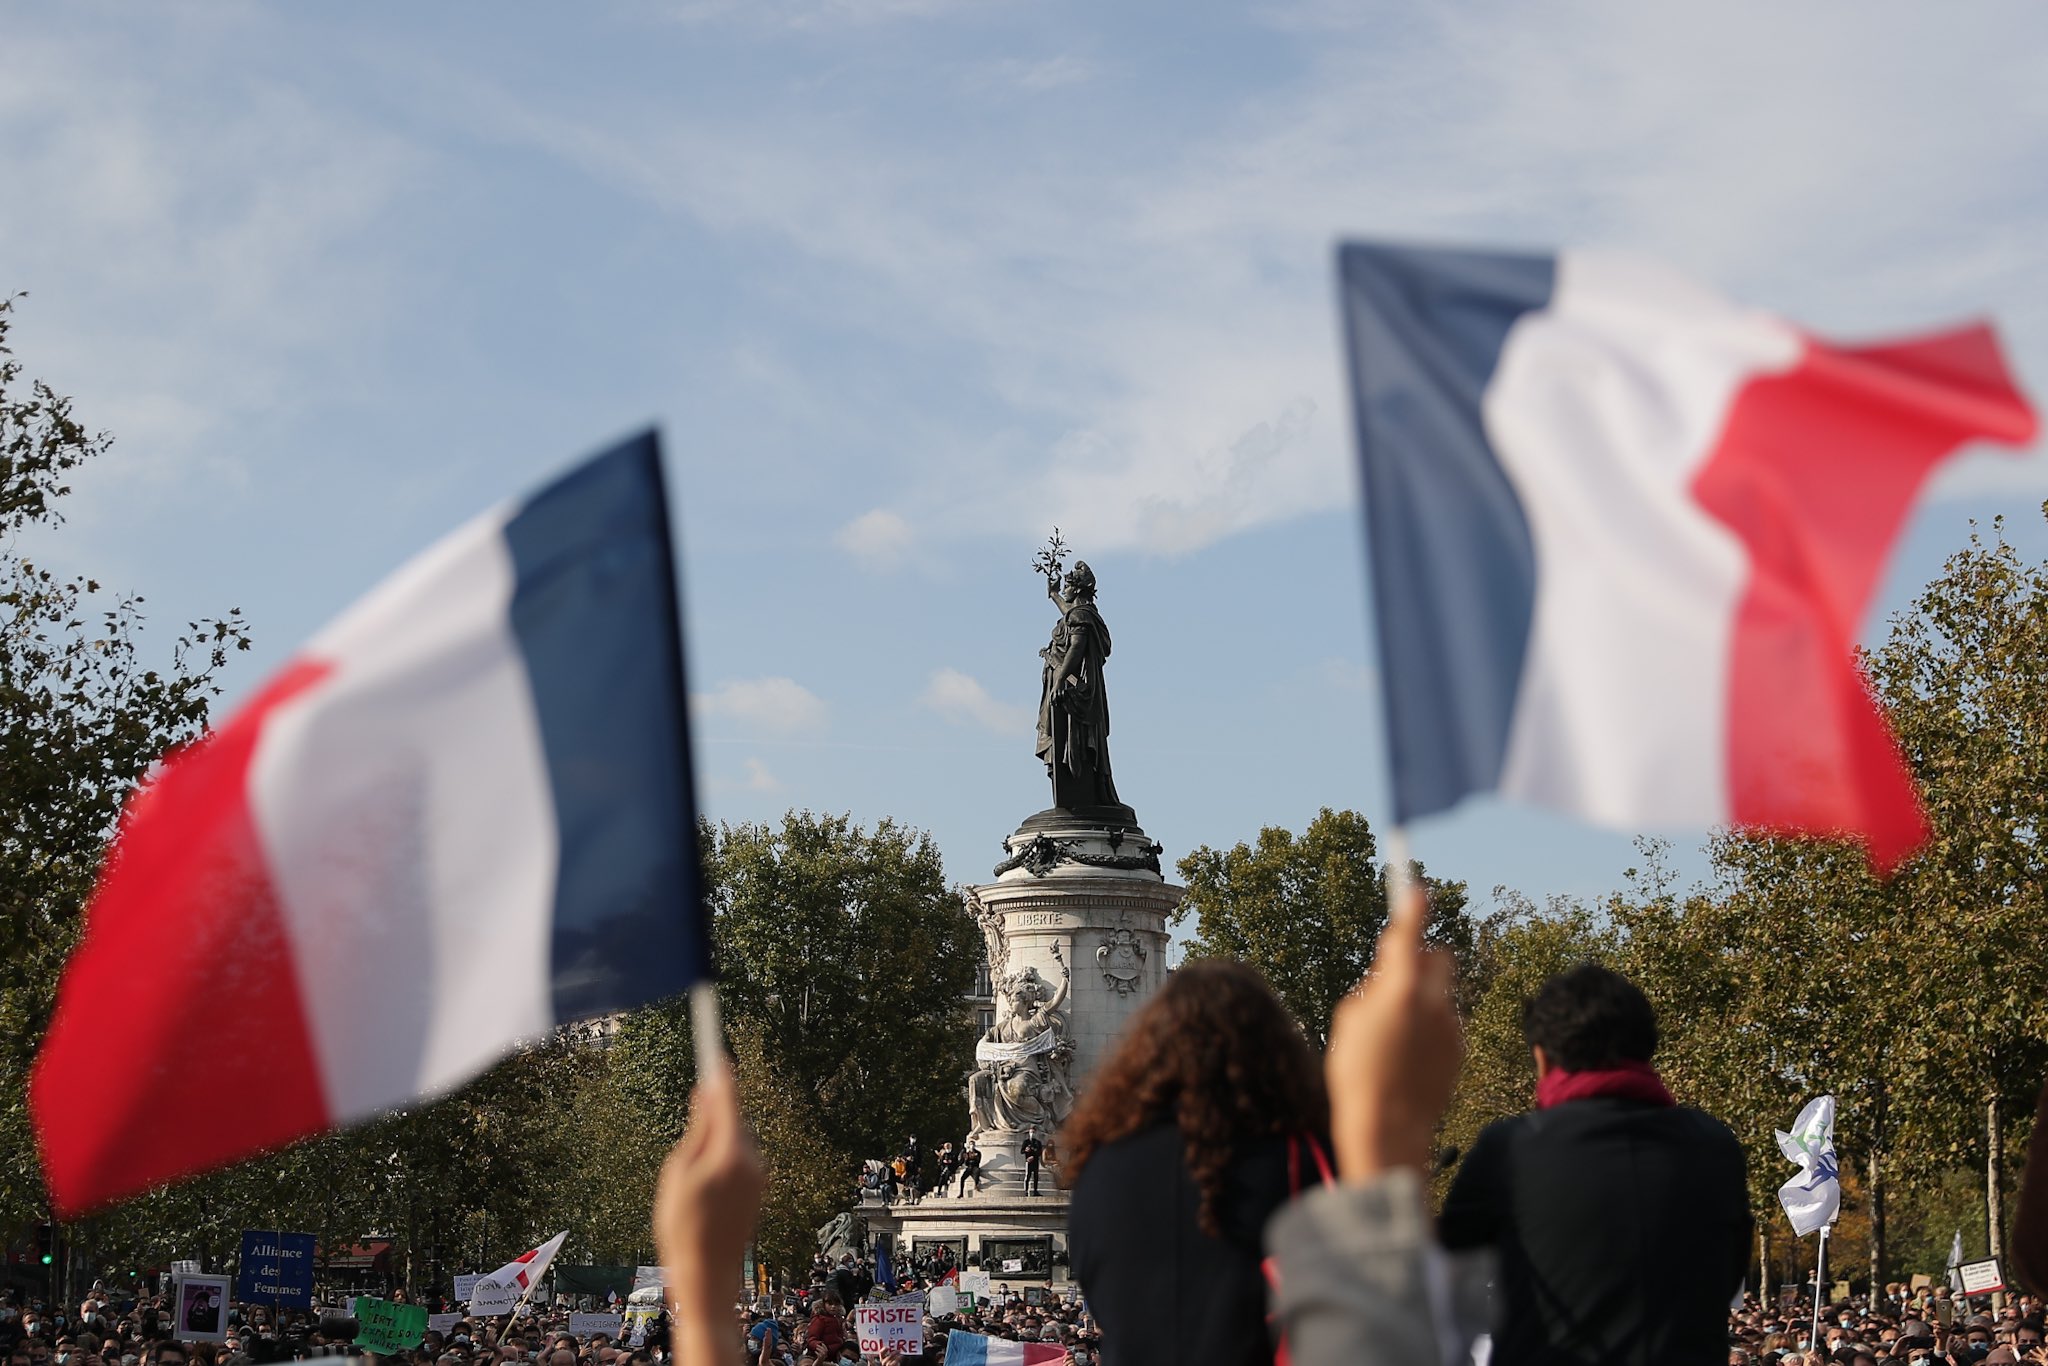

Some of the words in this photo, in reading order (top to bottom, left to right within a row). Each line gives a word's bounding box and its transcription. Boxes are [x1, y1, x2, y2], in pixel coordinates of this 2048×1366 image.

[251, 1245, 303, 1258] Alliance
[260, 1264, 281, 1277] des
[253, 1281, 302, 1296] Femmes
[858, 1307, 917, 1323] TRISTE
[868, 1325, 880, 1335] et
[889, 1327, 903, 1335] en
